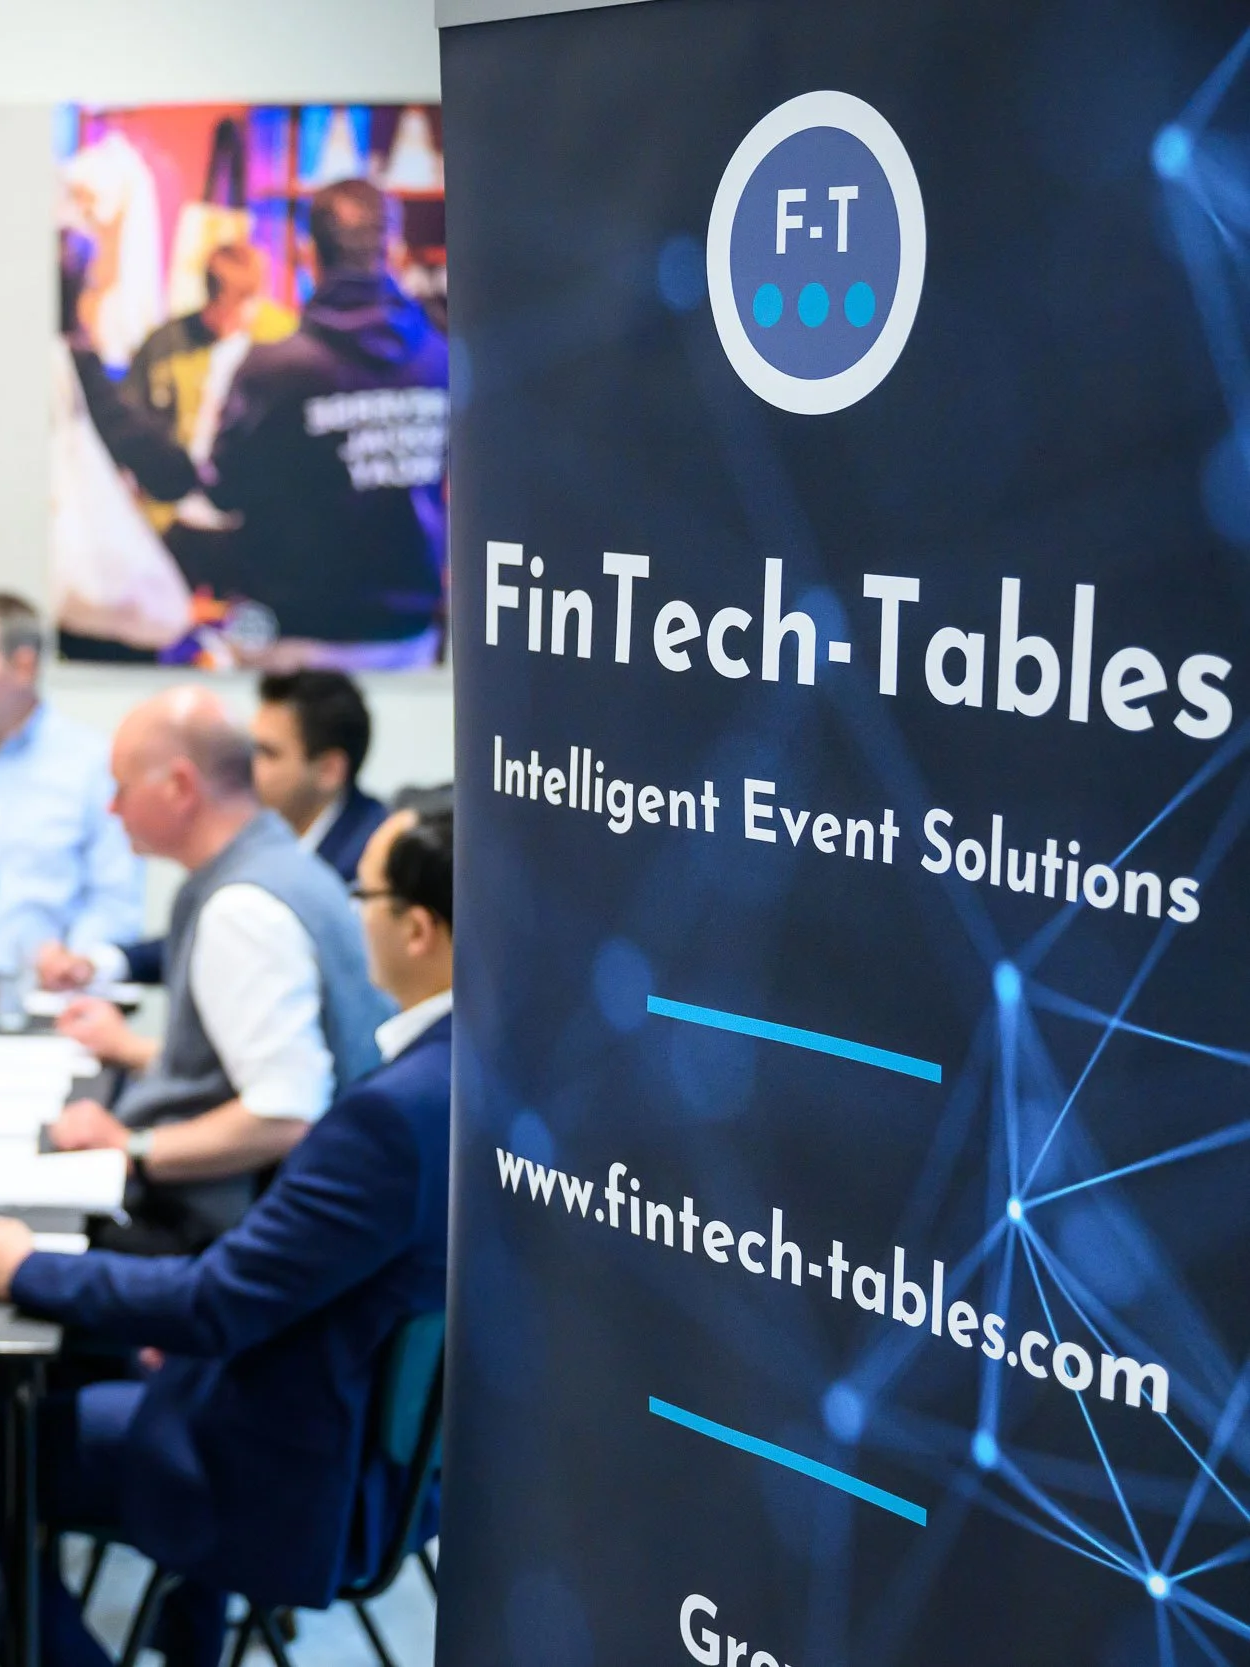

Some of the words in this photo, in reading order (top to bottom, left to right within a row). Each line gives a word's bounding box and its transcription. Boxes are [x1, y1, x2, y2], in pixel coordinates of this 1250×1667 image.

[775, 185, 859, 255] F-T
[485, 540, 1233, 740] FinTech-Tables
[493, 735, 720, 835] Intelligent
[744, 777, 900, 865] Event
[920, 808, 1200, 923] Solutions
[496, 1147, 1169, 1414] www.fintech-tables.com
